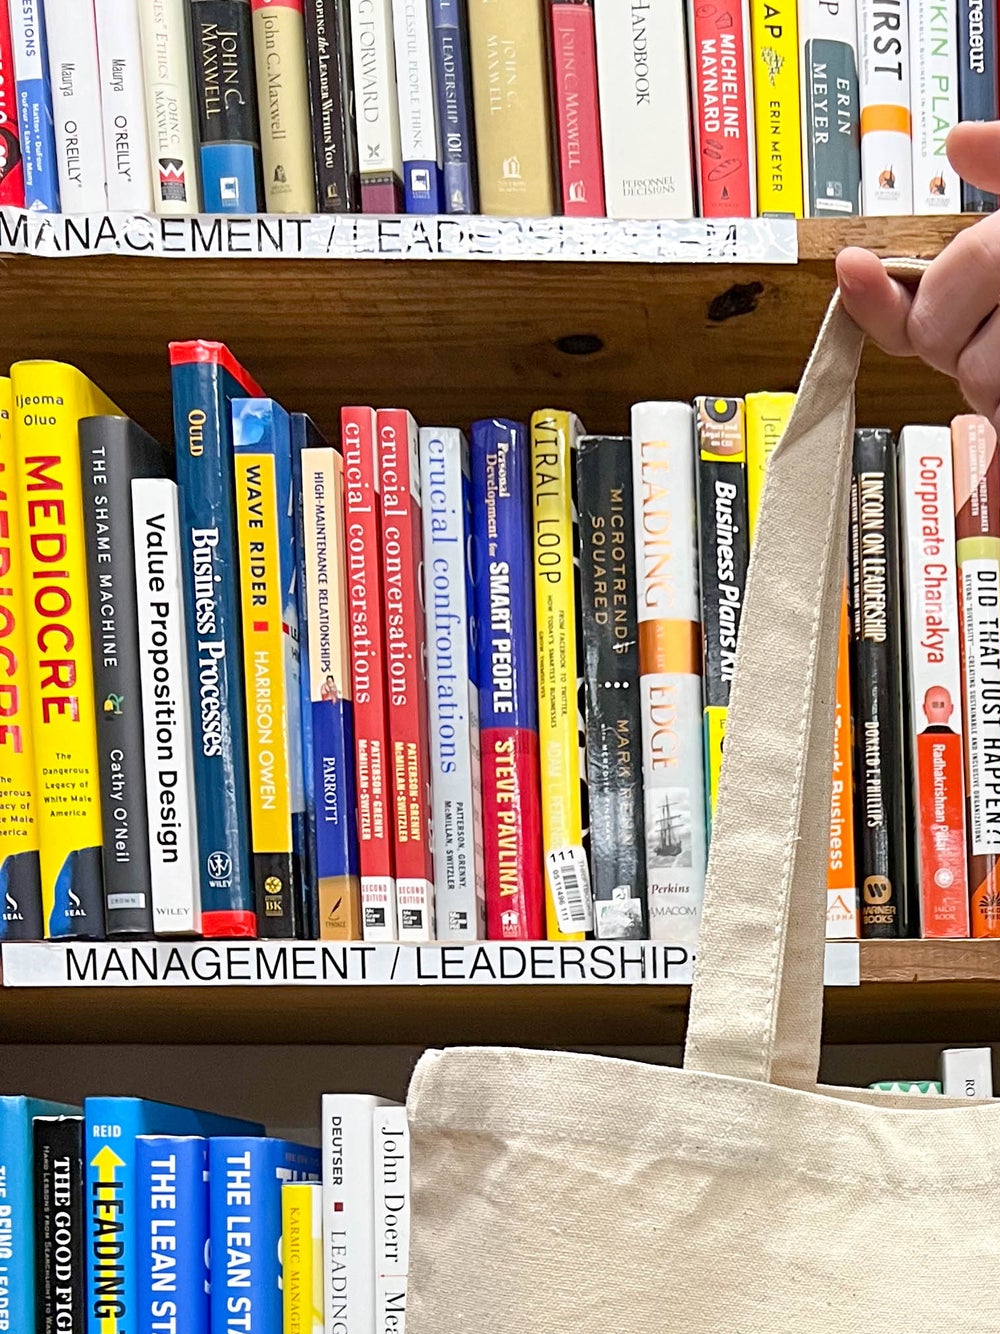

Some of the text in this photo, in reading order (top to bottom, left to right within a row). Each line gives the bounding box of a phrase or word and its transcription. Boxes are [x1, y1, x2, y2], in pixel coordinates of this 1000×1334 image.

[201, 23, 221, 119] MAXWELL
[360, 22, 379, 123] FORWARD
[701, 39, 720, 133] MAYNARD
[720, 33, 739, 139] MICHELINE
[812, 63, 829, 144] MEYER
[837, 77, 850, 135] ERIN
[770, 101, 782, 193] ERIN MEYER
[0, 218, 314, 252] MANAGEMENT
[16, 395, 64, 407] Ijeoma
[24, 414, 56, 426] Oluo
[246, 465, 268, 606] WAVE RIDER
[534, 418, 560, 584] VIRAL LOOP
[641, 440, 676, 608] LEADING
[24, 455, 81, 724] MEDIOCRE
[92, 446, 117, 667] THE SHAME MACHINE
[345, 423, 376, 704] crucial conversations
[381, 426, 412, 706] crucial conversations
[591, 516, 608, 625] SQUARED
[915, 456, 950, 664] Corporate Chanakya
[977, 571, 997, 607] DID
[191, 528, 225, 757] Business Processes
[429, 439, 464, 775] crucial confrontations
[490, 562, 513, 714] SMART PEOPLE
[980, 618, 1000, 670] THAT
[146, 513, 179, 863] Value Proposition Design
[649, 684, 680, 771] EDGE
[42, 767, 89, 775] Dangerous
[253, 651, 276, 810] HARRISON OWEN
[45, 781, 76, 790] Legacy
[50, 809, 87, 817] America
[71, 795, 91, 803] Male
[110, 749, 130, 863] Cathy O'Neil
[322, 756, 337, 824] PARROTT
[495, 740, 518, 897] STEVE PAVLINA
[156, 907, 190, 916] WILEY
[209, 880, 232, 888] WILEY
[651, 884, 690, 894] Perkins
[66, 945, 376, 982] MANAGEMENT
[390, 947, 400, 980] /
[93, 1125, 122, 1138] REID
[331, 1116, 343, 1186] DEUTSER
[54, 1157, 71, 1207] THE
[151, 1155, 176, 1210] THE
[227, 1151, 250, 1206] THE
[55, 1211, 71, 1281] GOOD
[93, 1182, 126, 1319] LEADING
[151, 1219, 176, 1292] LEAN
[227, 1217, 250, 1288] LEAN
